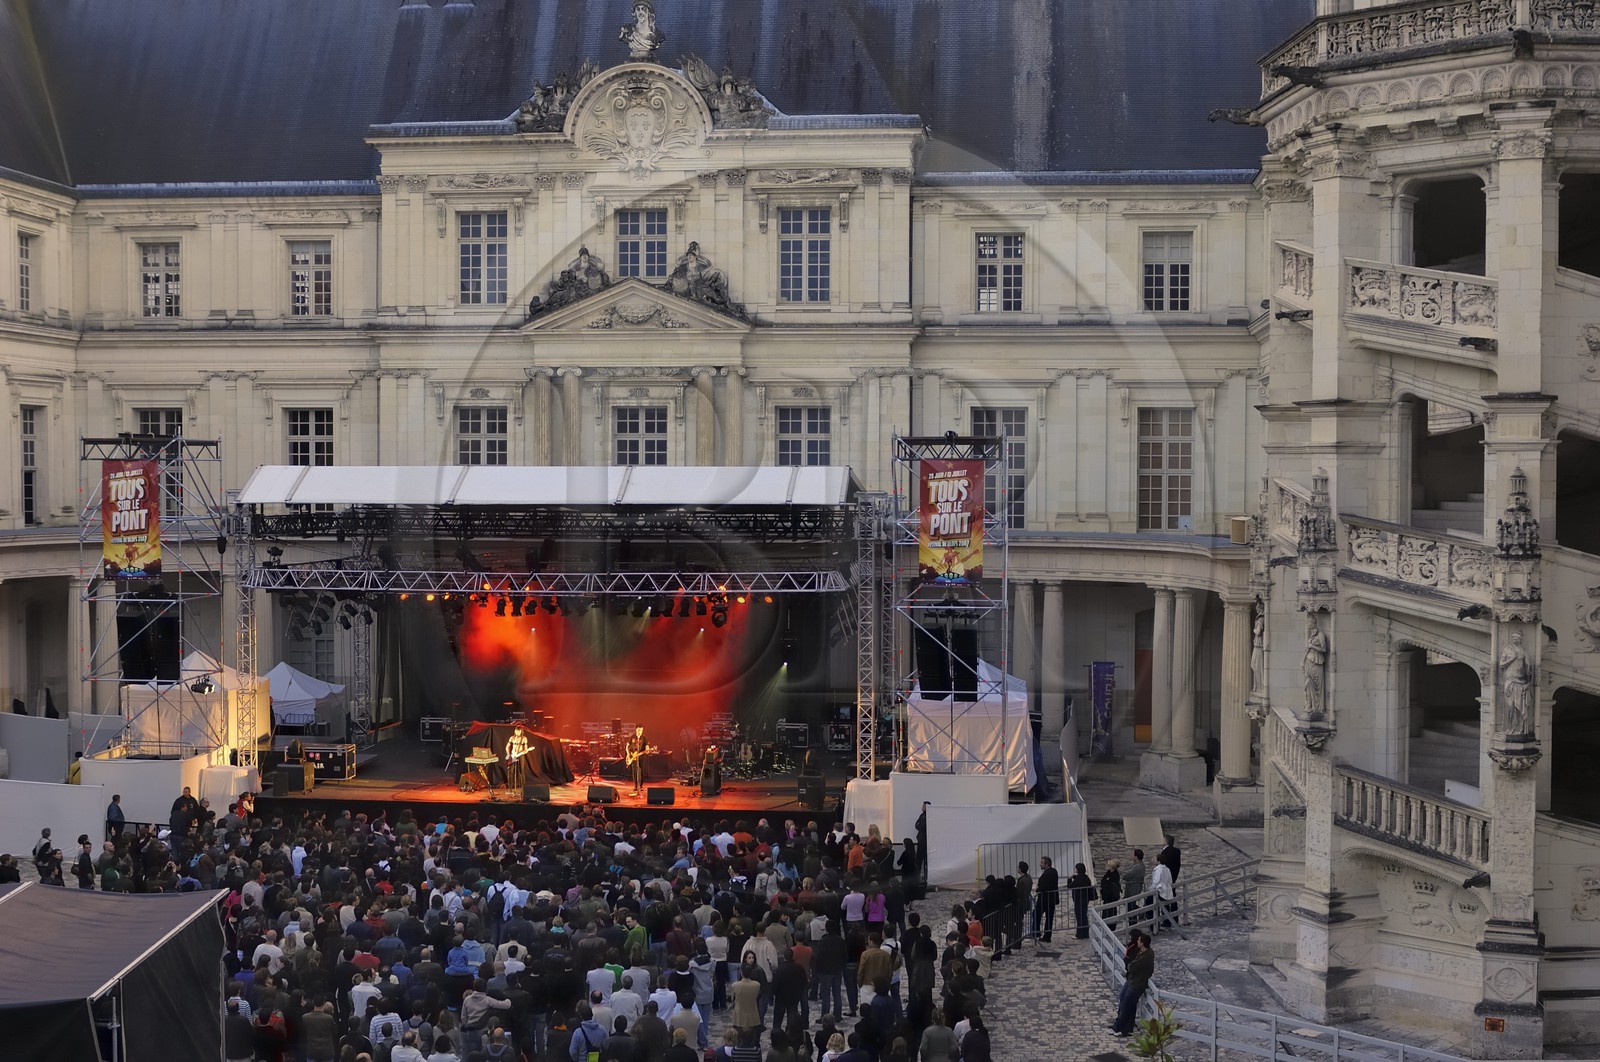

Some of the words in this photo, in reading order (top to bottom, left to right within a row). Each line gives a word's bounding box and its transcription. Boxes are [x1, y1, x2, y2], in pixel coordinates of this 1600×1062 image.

[110, 478, 145, 501] TOUS
[929, 479, 969, 503] TOUS
[117, 499, 131, 511] SUR
[132, 498, 140, 510] LE
[937, 502, 952, 513] SUR
[953, 501, 963, 512] LE
[112, 509, 149, 532] PONT
[930, 512, 971, 536] PONT
